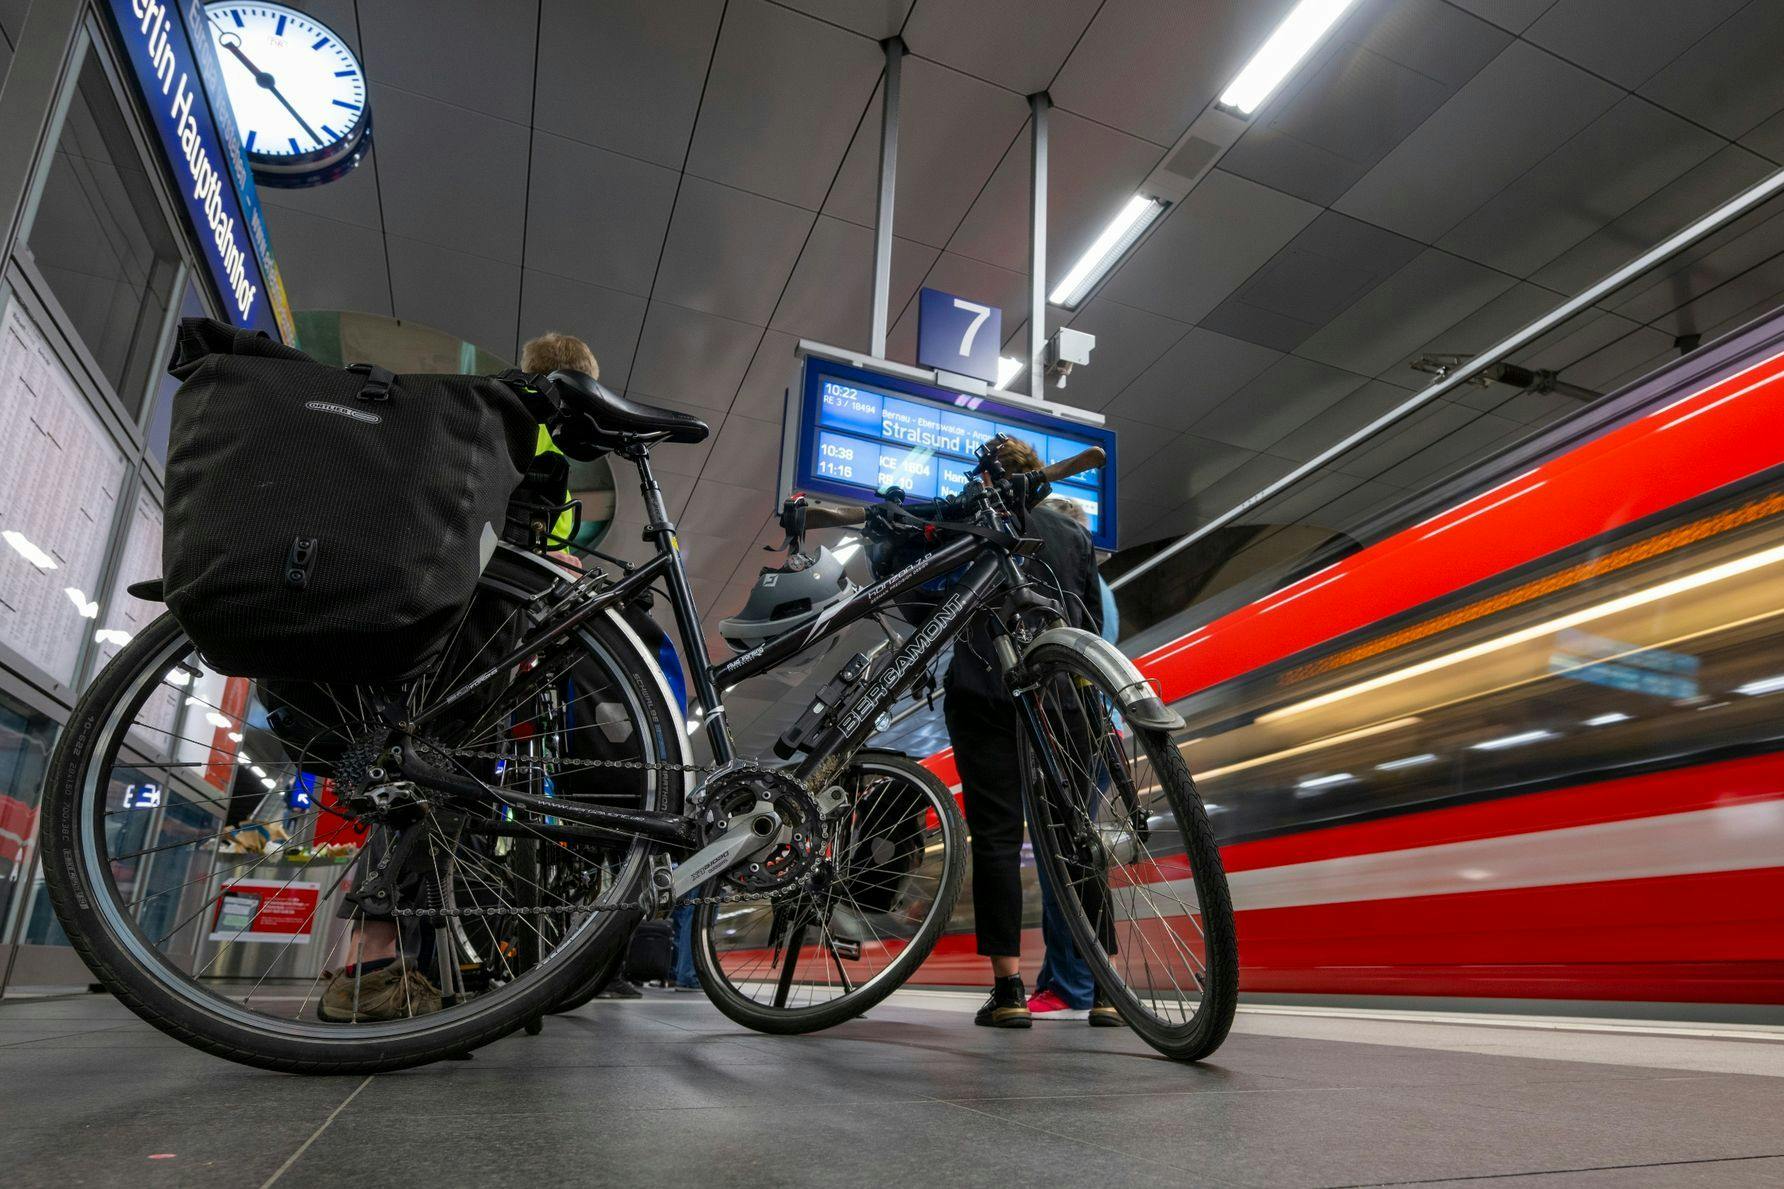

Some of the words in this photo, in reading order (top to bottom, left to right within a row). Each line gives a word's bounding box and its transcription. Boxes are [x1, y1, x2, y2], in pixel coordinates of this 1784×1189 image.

[171, 72, 257, 321] Hauptbahnhof
[953, 298, 991, 357] 7
[823, 394, 834, 405] RE
[836, 397, 842, 407] 3
[825, 382, 858, 400] 10:22
[882, 409, 911, 424] Bernau
[917, 417, 966, 436] Eberswalde
[882, 420, 960, 452] Stralsund
[821, 443, 854, 461] 10:38
[879, 456, 897, 469] ICE
[819, 461, 853, 478] 11:16
[878, 472, 895, 485] RB
[898, 475, 913, 490] 10
[837, 592, 964, 739] BERGAMONT
[632, 672, 660, 722] SCHWALBE
